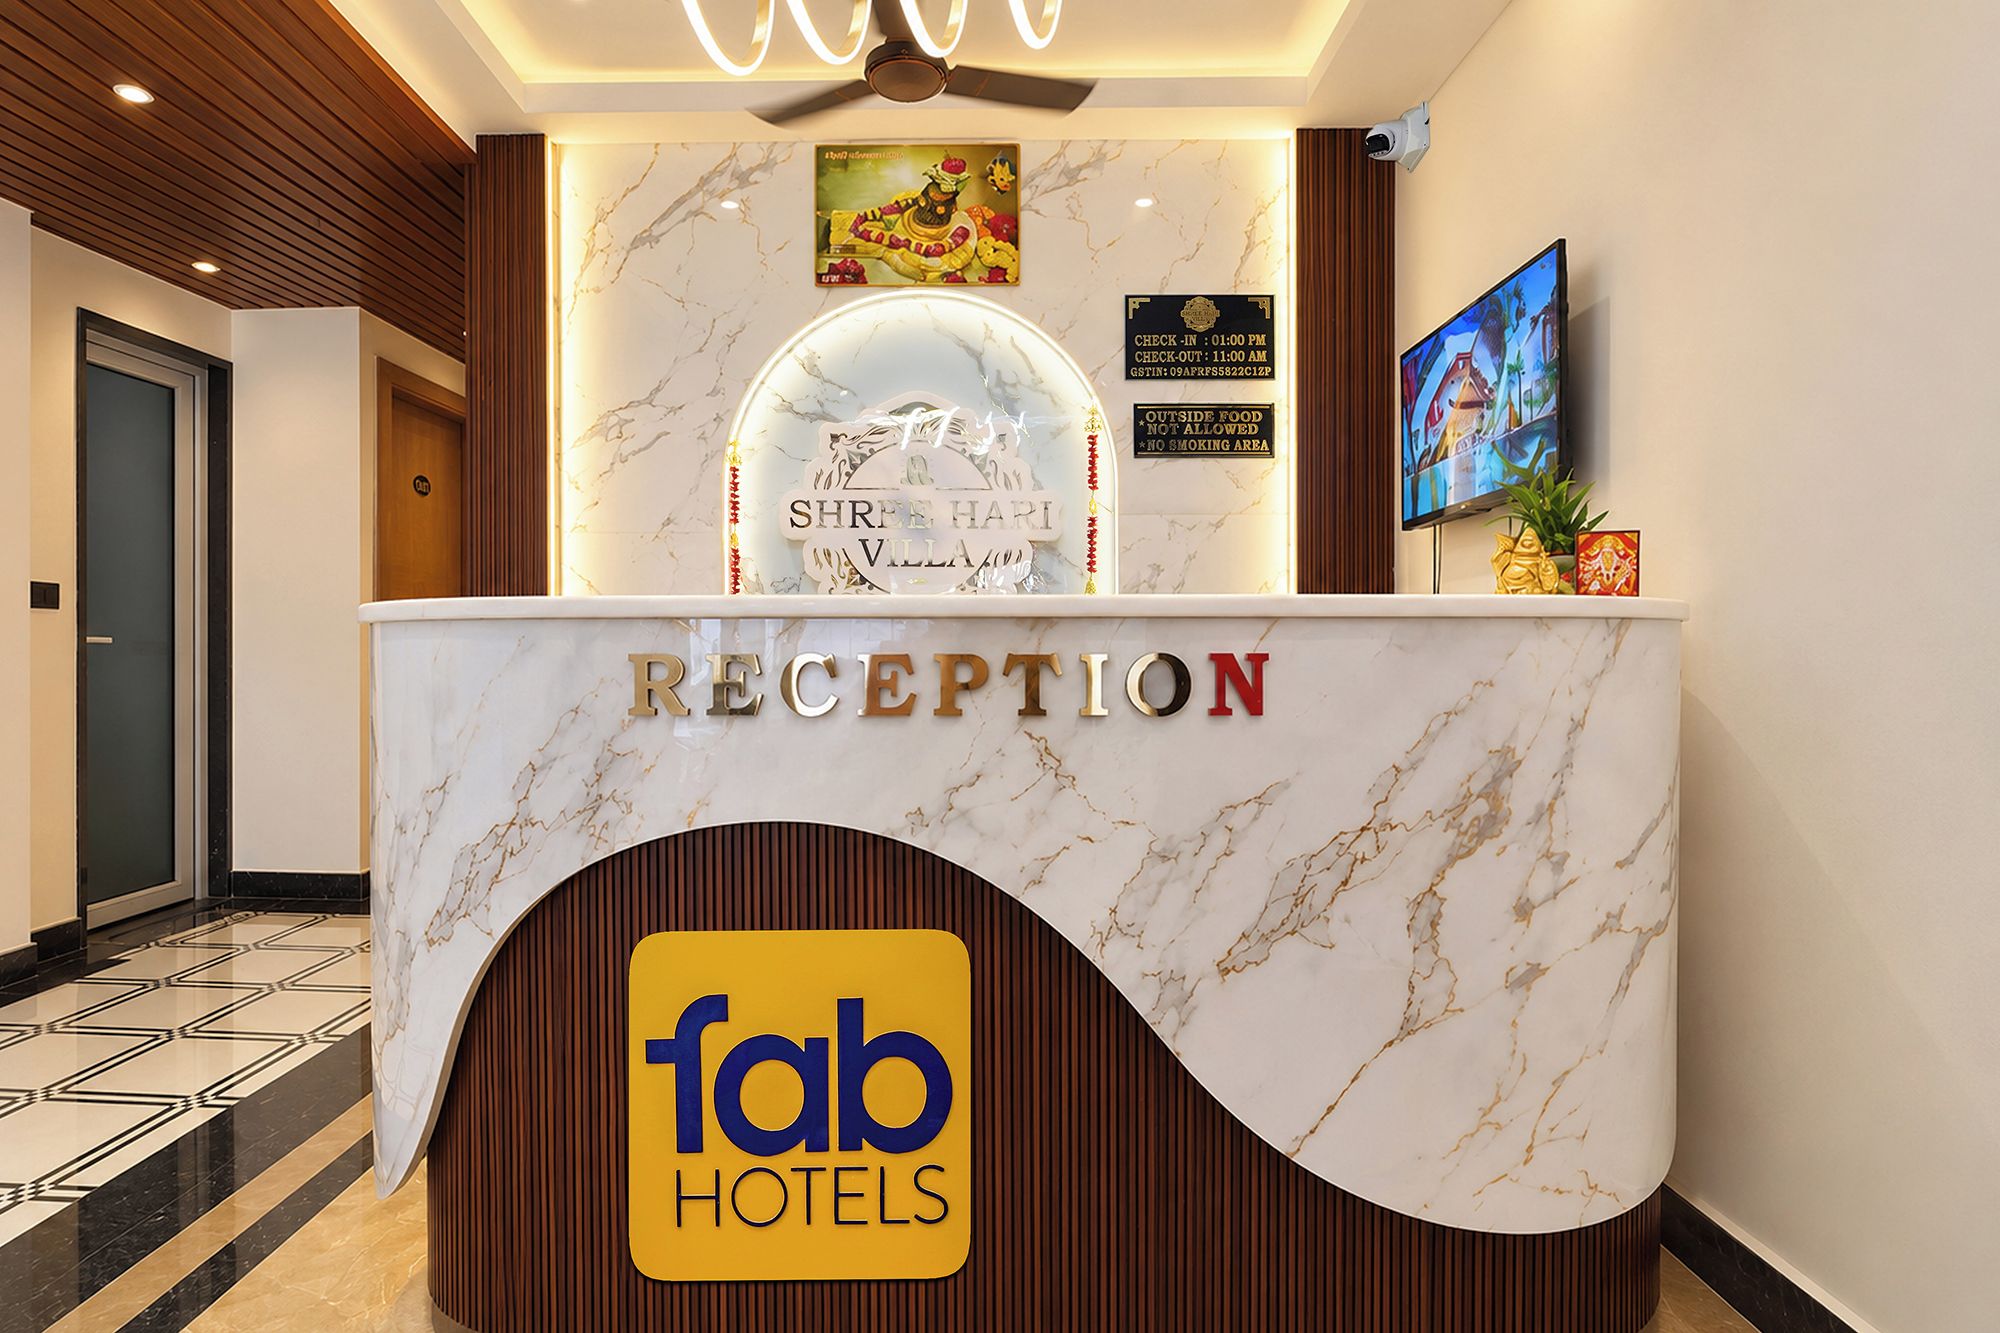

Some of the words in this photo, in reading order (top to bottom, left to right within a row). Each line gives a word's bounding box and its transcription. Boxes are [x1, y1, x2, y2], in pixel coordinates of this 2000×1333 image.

[1134, 334, 1177, 347] CHECK
[1211, 334, 1245, 346] 01:00
[1248, 334, 1266, 346] PM
[1212, 350, 1245, 363] 11:00
[1248, 350, 1267, 362] AM
[1145, 410, 1215, 423] OUTSIDE
[1218, 410, 1263, 423] FOOD
[1146, 423, 1180, 435] NOT
[1183, 423, 1259, 435] ALLOWED
[1146, 439, 1165, 451] NO
[1168, 439, 1231, 451] SMOKING
[1233, 439, 1270, 451] AREA
[789, 499, 934, 530] SHREE
[949, 500, 1053, 531] HARI
[858, 537, 975, 569] VILLA
[627, 652, 1271, 718] RECEPTION
[645, 993, 953, 1157] fab
[675, 1163, 949, 1229] HOTELS
